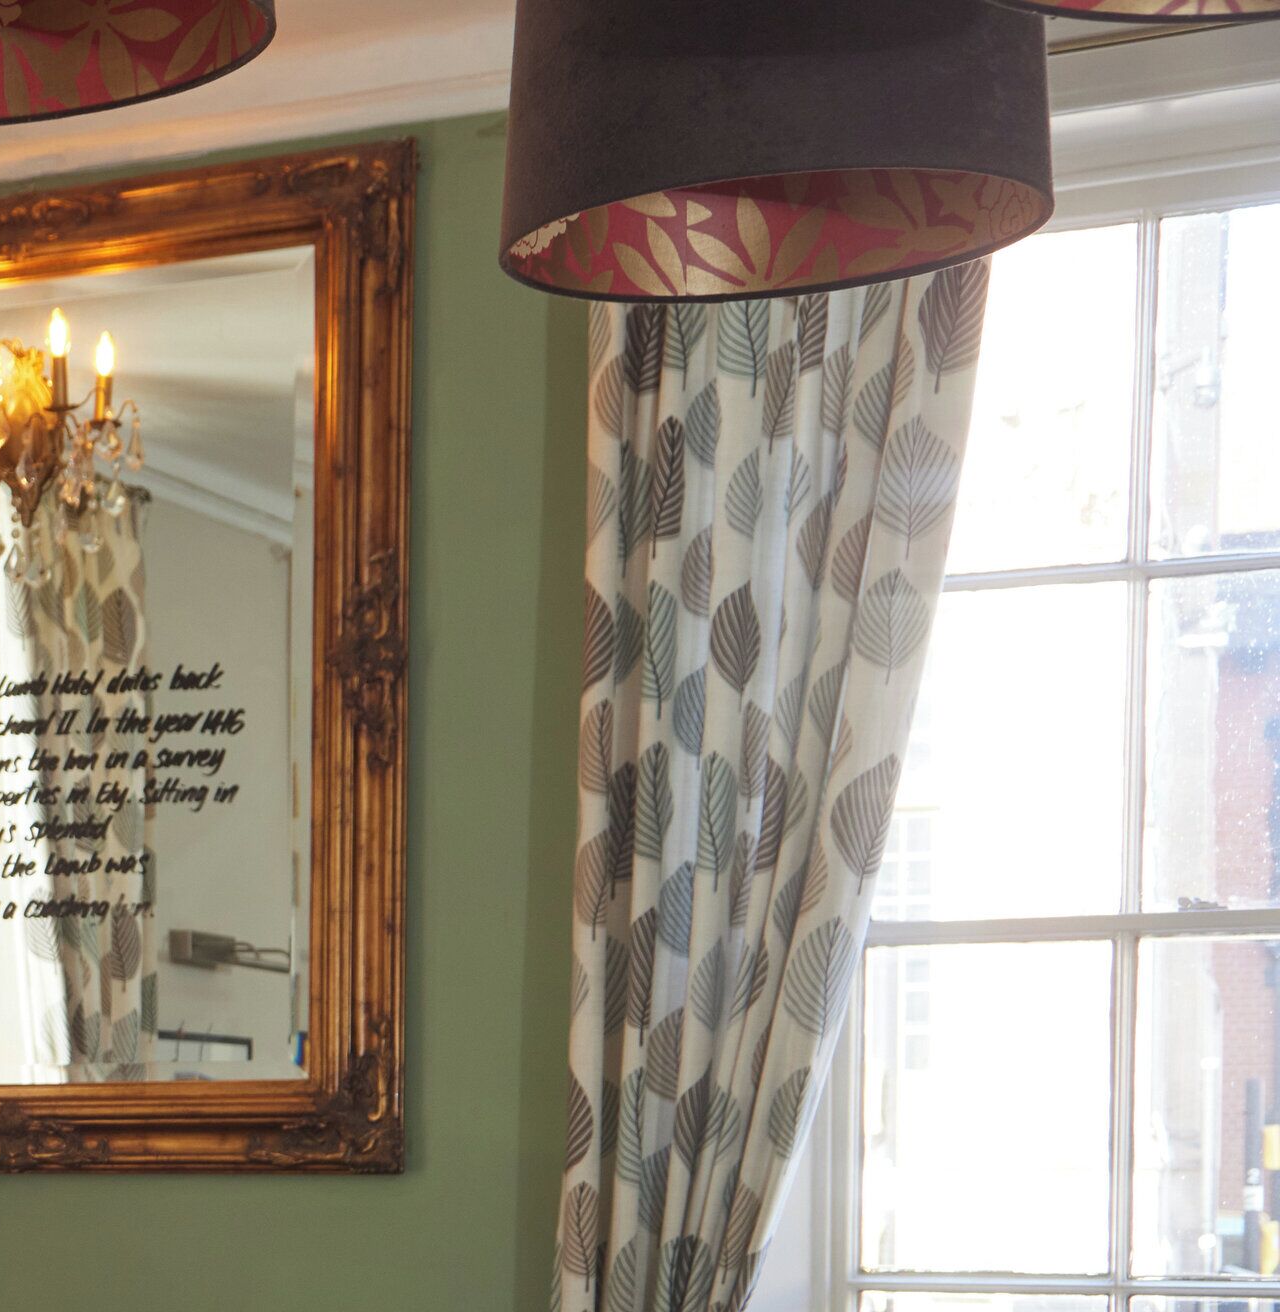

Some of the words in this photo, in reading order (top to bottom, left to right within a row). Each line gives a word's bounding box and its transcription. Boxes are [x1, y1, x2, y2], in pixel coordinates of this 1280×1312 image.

[51, 669, 105, 695] Hotel
[107, 665, 162, 693] dates
[169, 663, 224, 690] back
[114, 707, 151, 734] the
[149, 711, 202, 743] year
[28, 749, 60, 771] the
[105, 749, 130, 770] in
[153, 749, 226, 776] survey
[95, 781, 131, 811] Ely.
[141, 778, 209, 812] Sitting
[213, 782, 239, 804] in
[2, 853, 37, 878] the
[105, 853, 150, 875] was
[3, 901, 18, 919] a
[24, 893, 110, 923] coaching
